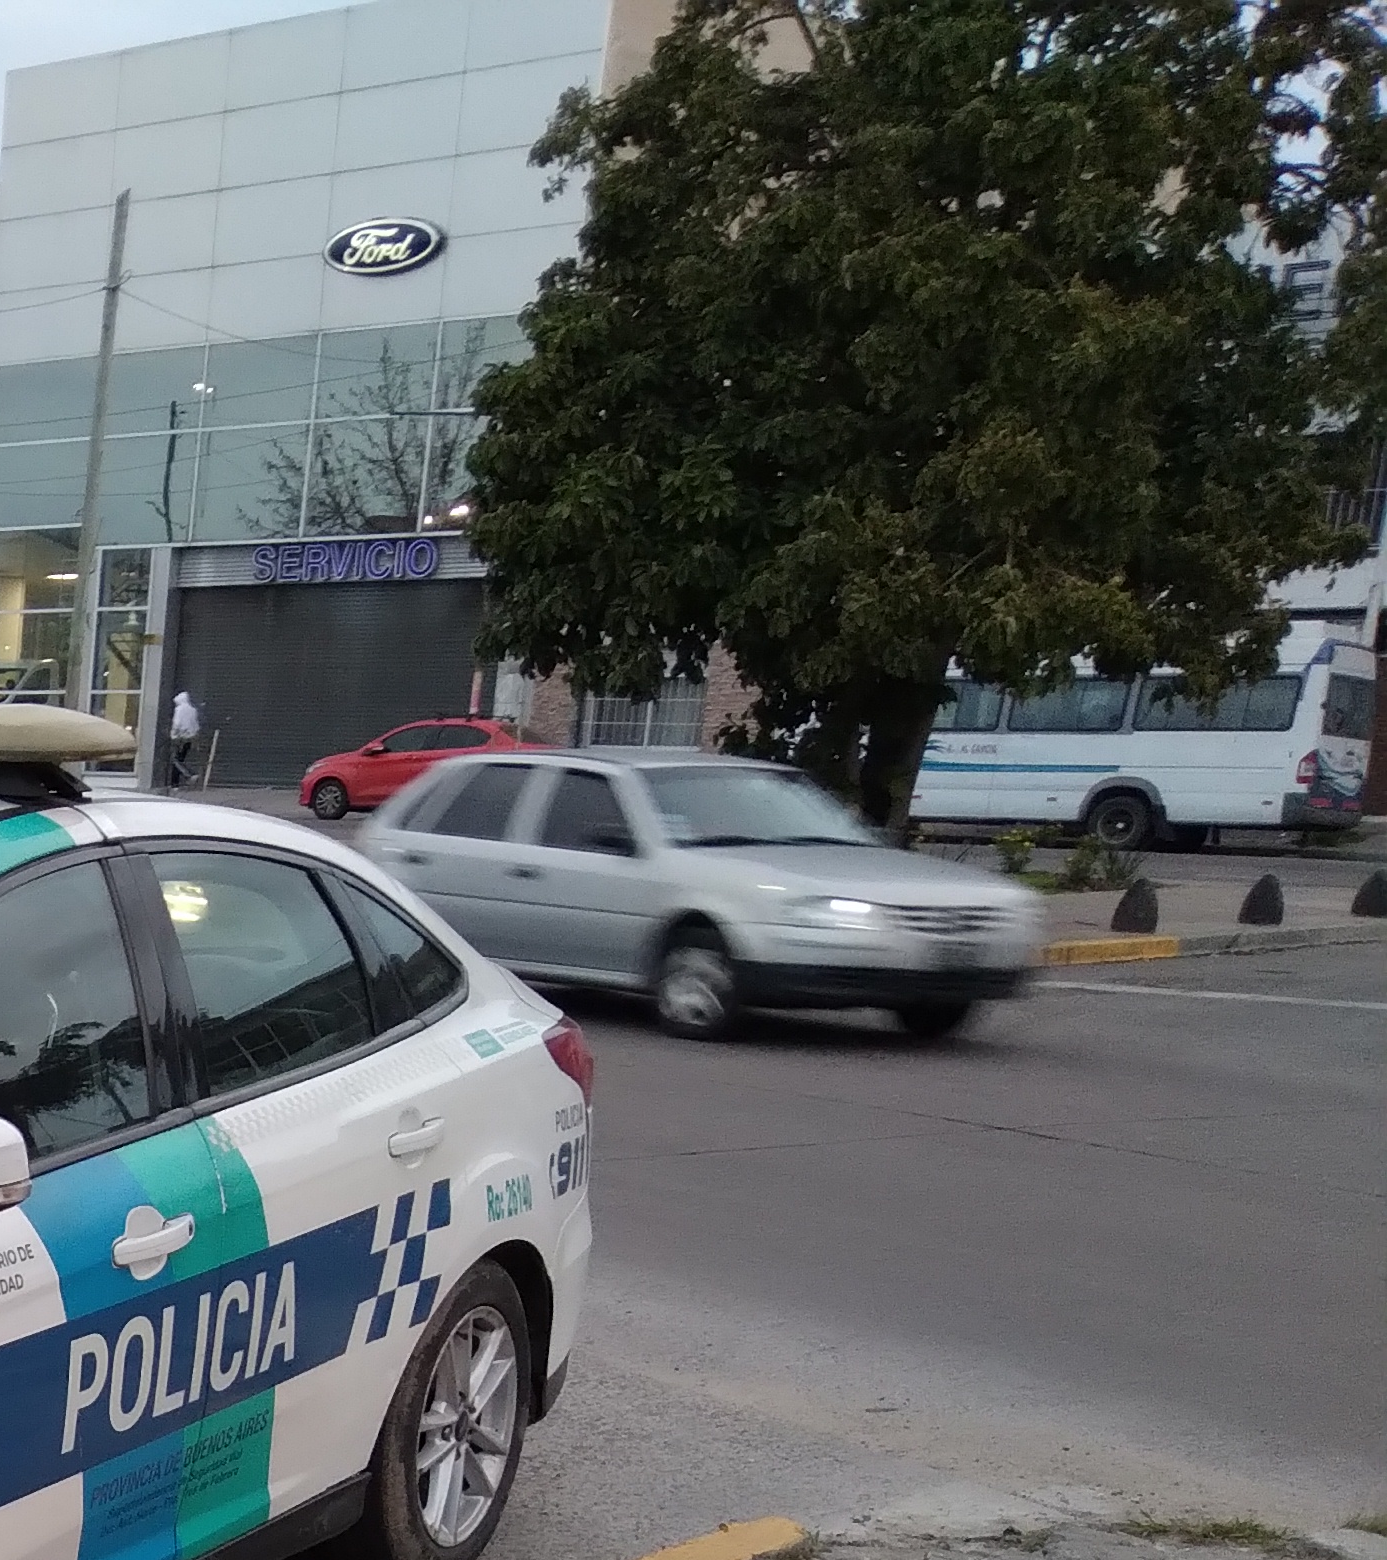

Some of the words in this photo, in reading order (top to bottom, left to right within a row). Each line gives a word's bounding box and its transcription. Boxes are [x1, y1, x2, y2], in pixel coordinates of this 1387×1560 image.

[343, 227, 416, 265] Ford
[252, 538, 438, 583] SERVICIO
[557, 1133, 586, 1197] 911
[16, 1243, 35, 1262] DE
[61, 1260, 296, 1455] POLICIA
[90, 1460, 162, 1510] PROVINCIA
[165, 1449, 183, 1476] DE
[183, 1426, 234, 1469] BUENOS
[234, 1408, 271, 1442] AIRES
